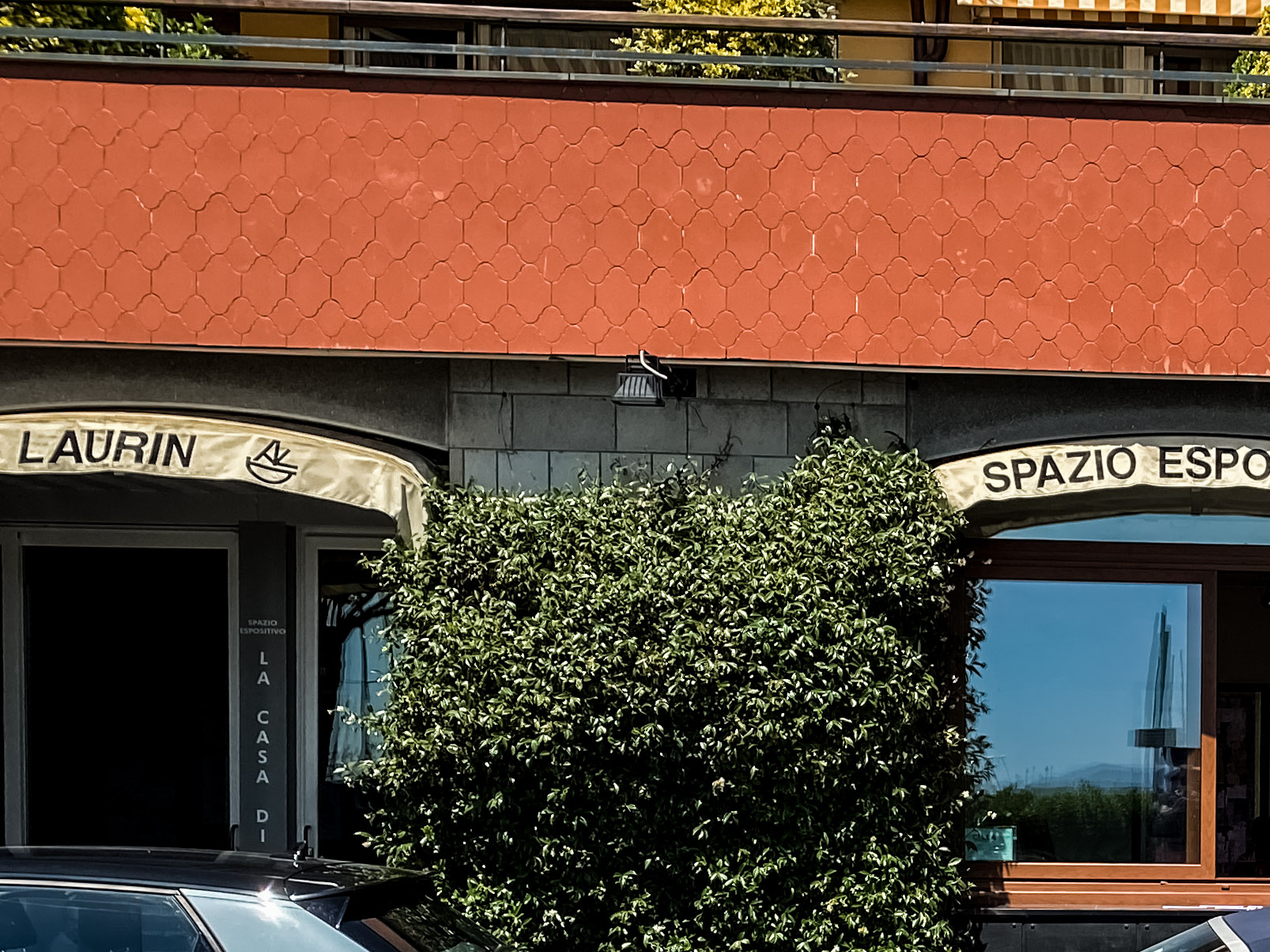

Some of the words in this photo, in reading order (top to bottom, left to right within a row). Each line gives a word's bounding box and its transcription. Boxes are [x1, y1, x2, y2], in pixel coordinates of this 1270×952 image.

[18, 430, 197, 468] LAURIN
[983, 445, 1138, 494] SPAZIO
[257, 651, 270, 685] LA
[256, 710, 270, 784] CASA
[256, 809, 269, 843] DI
